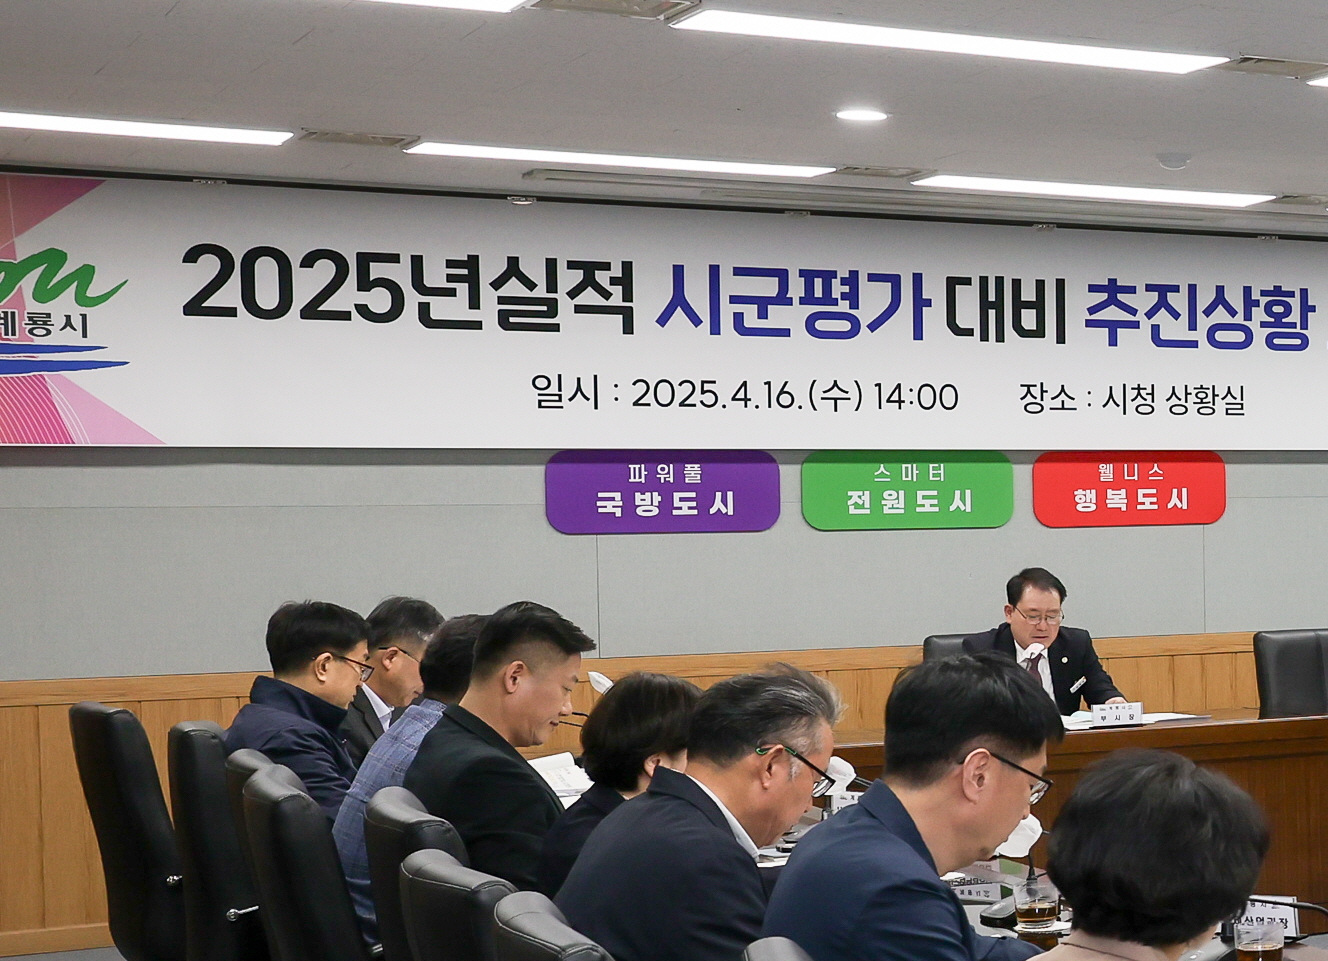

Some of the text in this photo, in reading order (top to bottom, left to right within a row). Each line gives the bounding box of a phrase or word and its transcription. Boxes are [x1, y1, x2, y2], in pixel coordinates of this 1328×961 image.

[181, 242, 635, 335] 2025년실적
[654, 263, 933, 341] 시군평가
[945, 275, 1067, 345] 대비
[1084, 276, 1317, 352] 추진상황
[531, 373, 600, 411] 일시
[631, 377, 863, 413] 2025.4.16.(수)
[873, 381, 960, 411] 14:00
[1018, 381, 1079, 415] 장소
[1101, 382, 1157, 416] 시청
[1164, 384, 1246, 416] 상황실
[628, 463, 703, 484] 파워풀
[873, 463, 946, 482] 스마터
[1098, 463, 1165, 482] 웰니스
[595, 490, 735, 517] 국방도시
[847, 489, 973, 515] 전원도시
[1073, 487, 1189, 513] 행복도시
